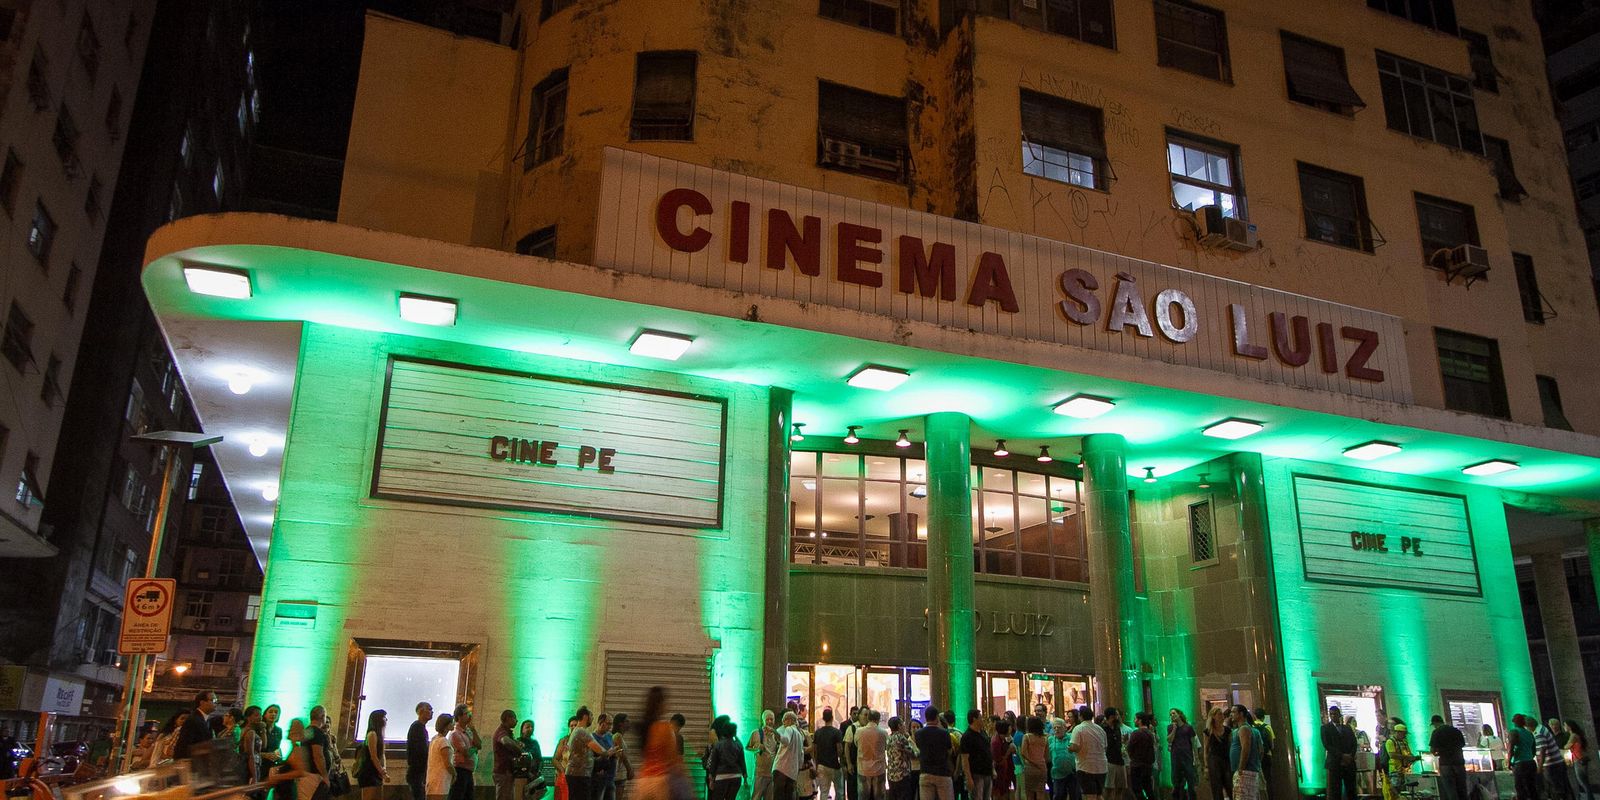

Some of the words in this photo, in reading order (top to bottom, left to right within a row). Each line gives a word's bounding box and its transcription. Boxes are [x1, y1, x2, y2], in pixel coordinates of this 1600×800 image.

[655, 187, 1019, 314] CINEMA
[1059, 268, 1198, 343] SÃO
[1228, 303, 1385, 382] LUIZ
[490, 435, 559, 466] CINE
[579, 445, 616, 471] PE
[1351, 531, 1388, 552] CINE
[1401, 536, 1424, 557] PE
[992, 610, 1054, 636] LUIZ
